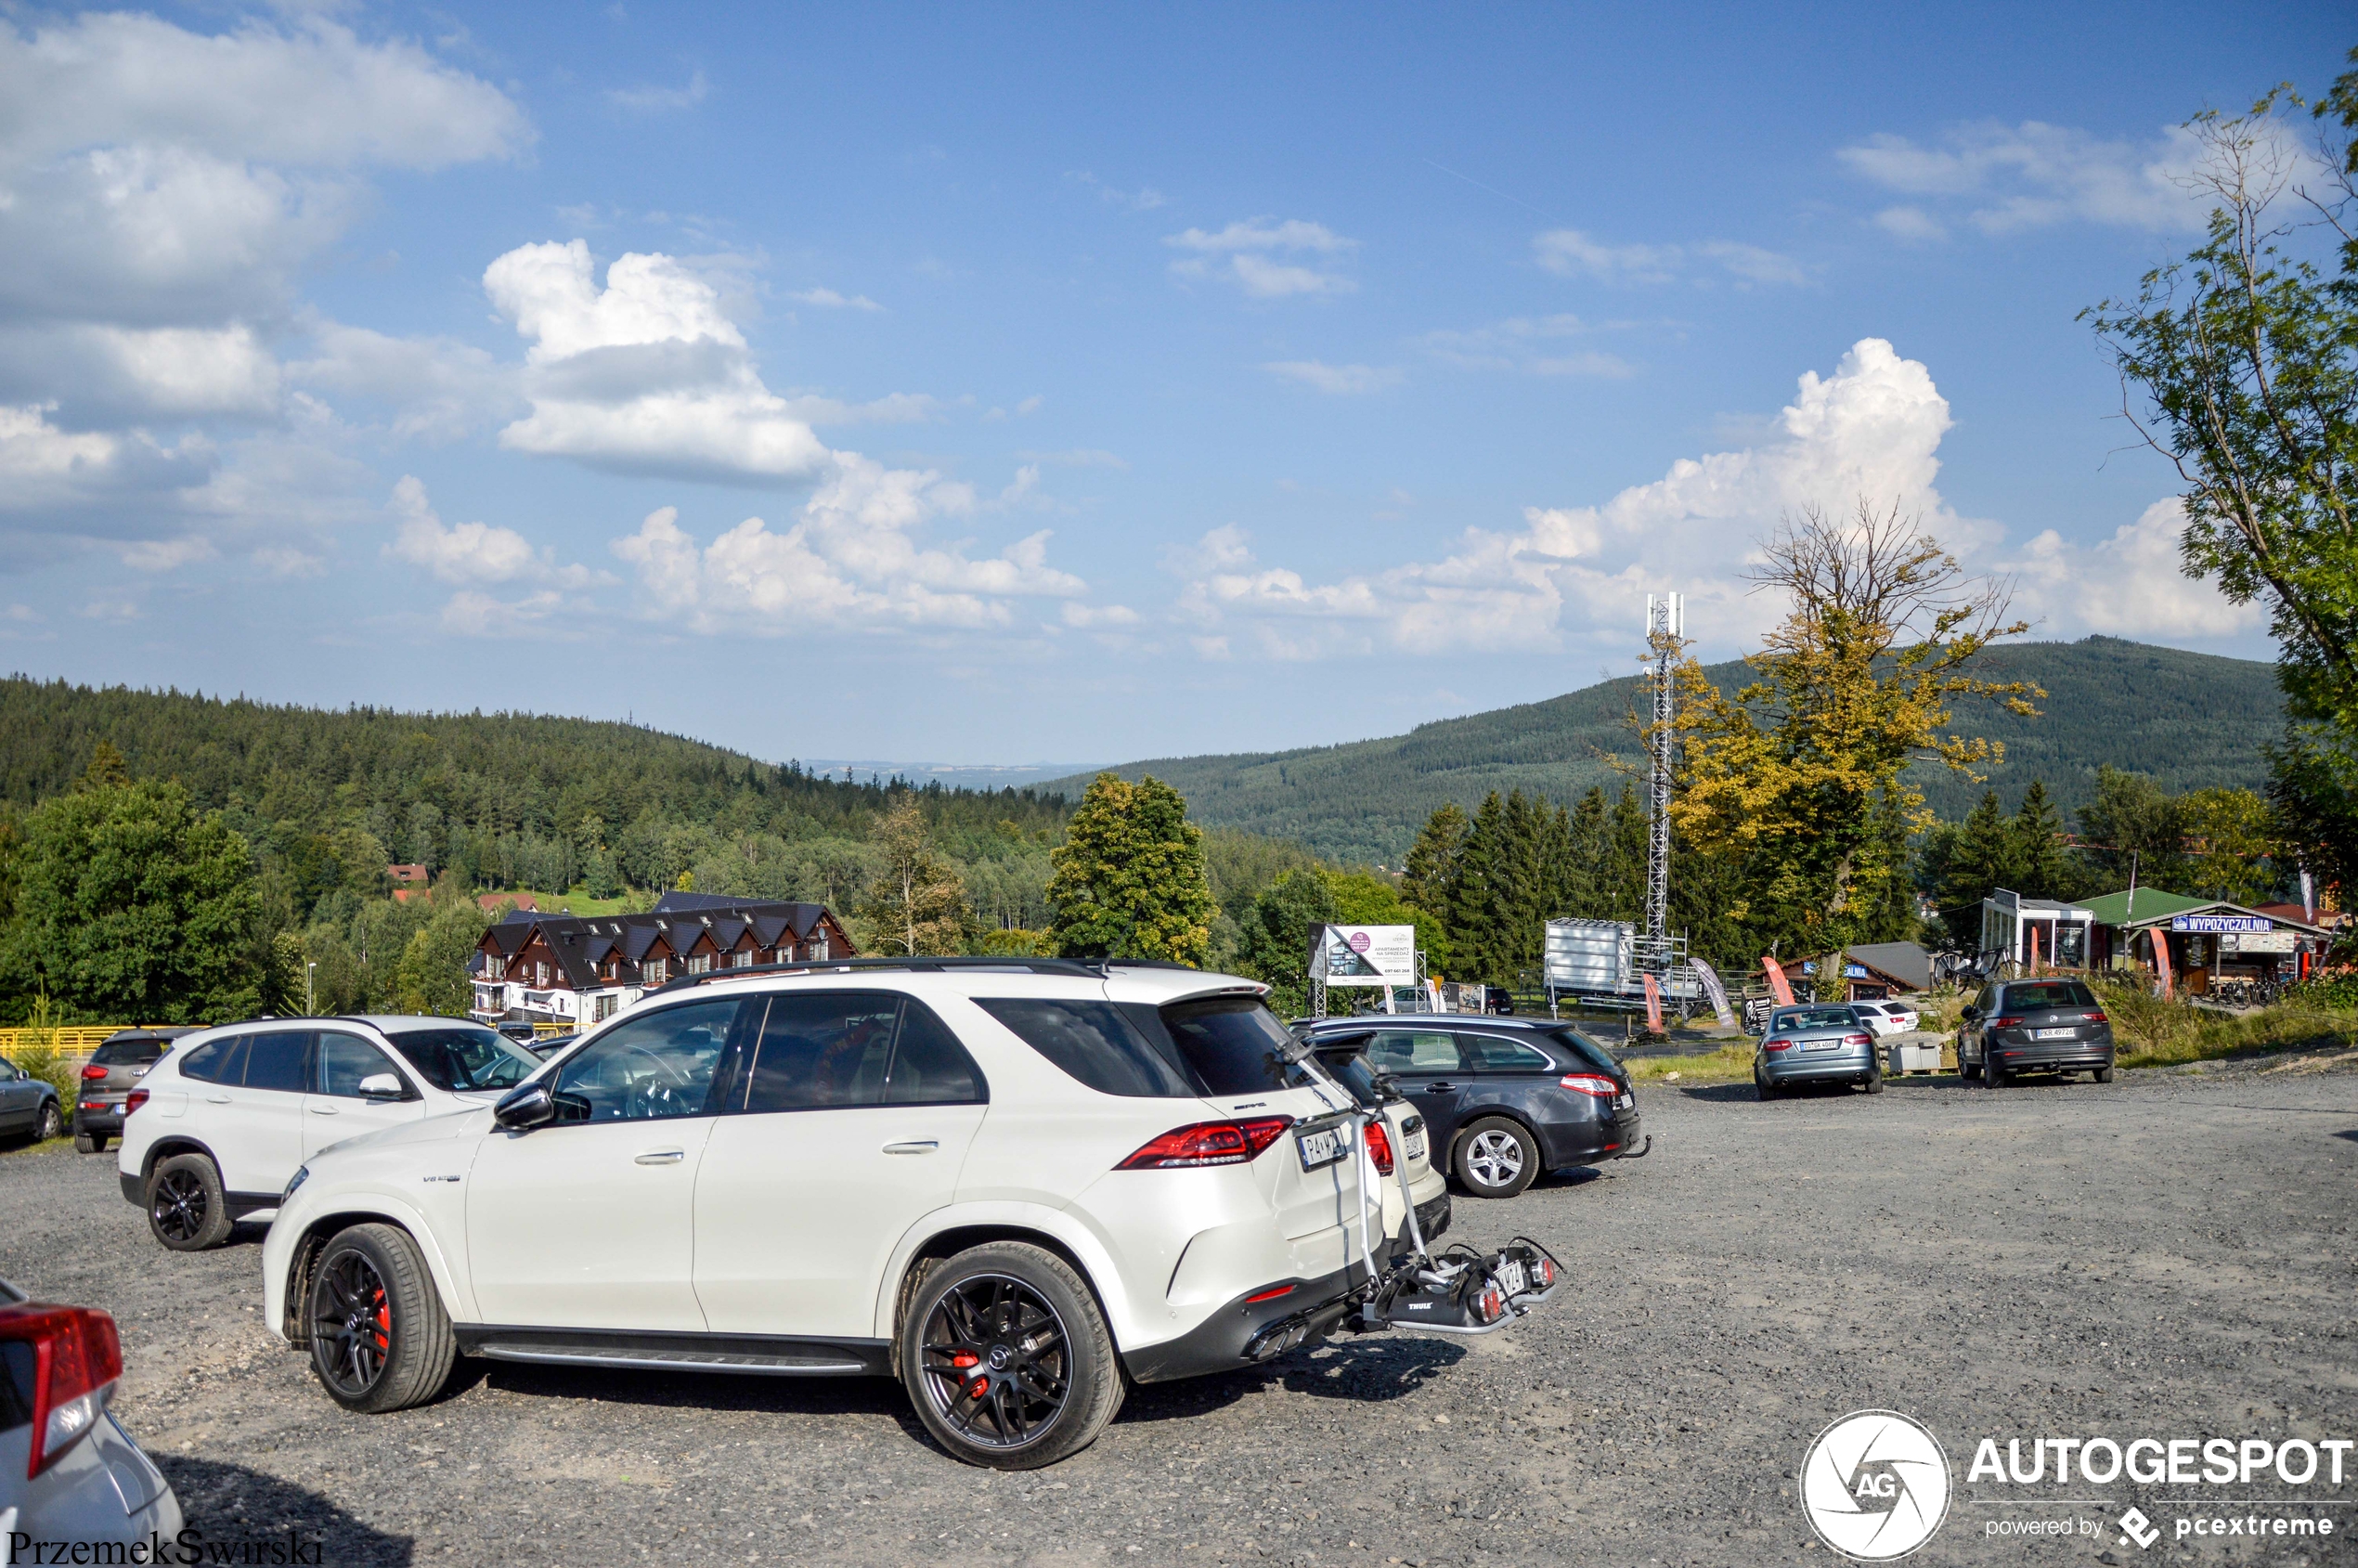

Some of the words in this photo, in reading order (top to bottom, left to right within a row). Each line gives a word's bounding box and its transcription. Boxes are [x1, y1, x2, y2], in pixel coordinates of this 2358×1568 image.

[2189, 917, 2270, 932] WYPOŻYCZALNIA
[2041, 1029, 2054, 1037] PKR
[2054, 1028, 2074, 1036] 49726
[1821, 1040, 1835, 1048] 4069
